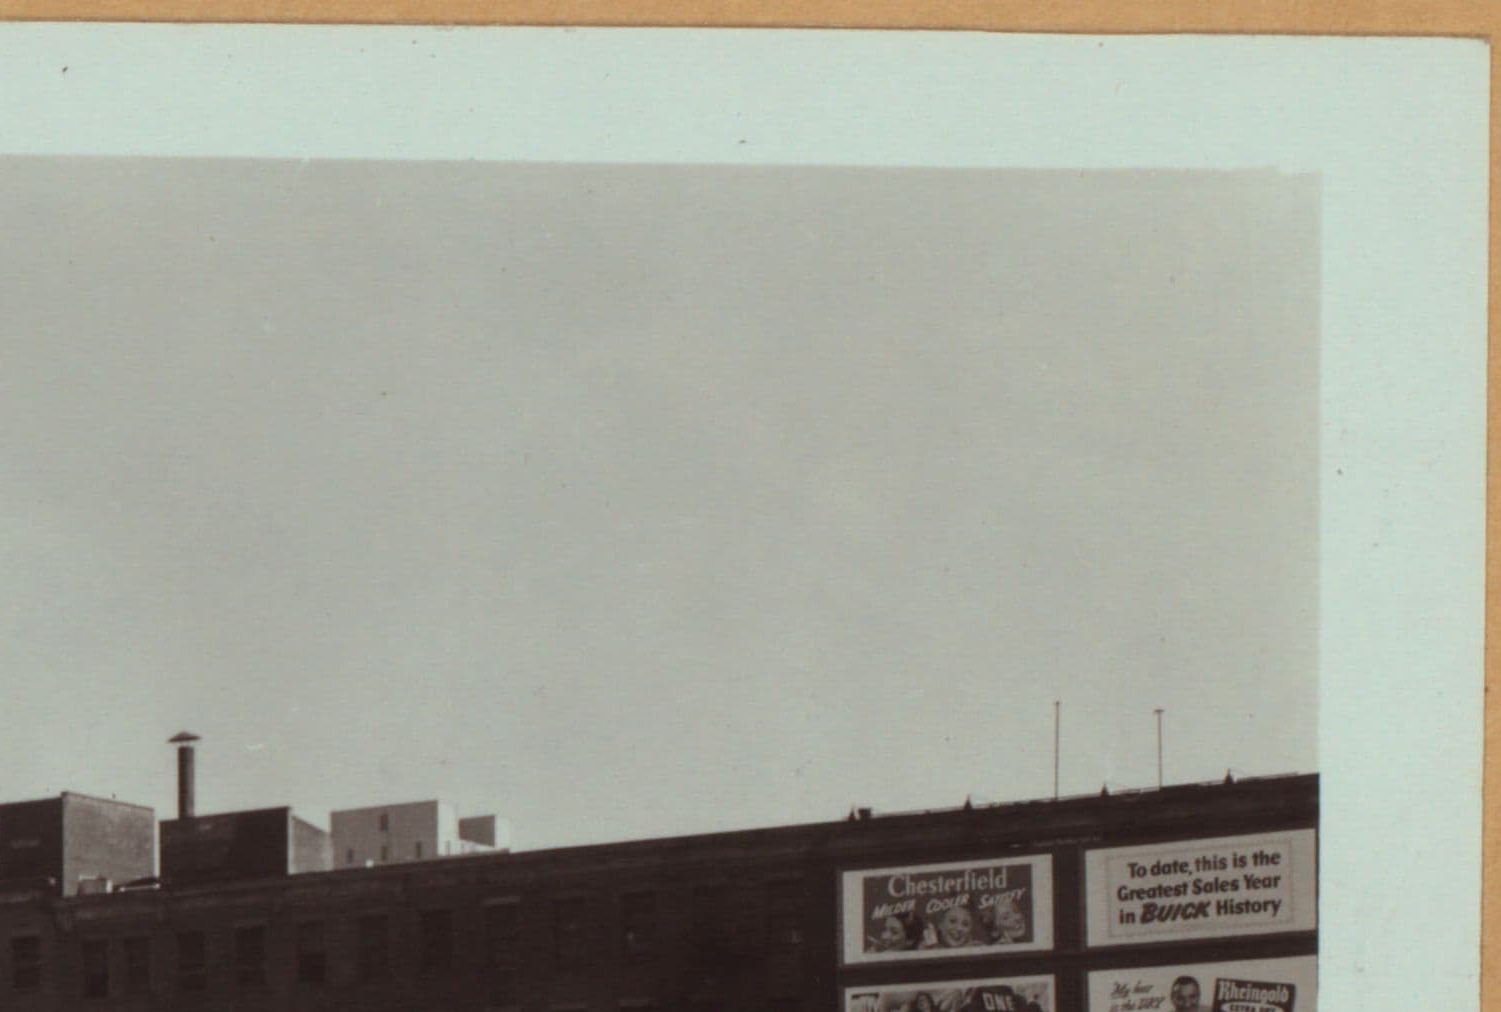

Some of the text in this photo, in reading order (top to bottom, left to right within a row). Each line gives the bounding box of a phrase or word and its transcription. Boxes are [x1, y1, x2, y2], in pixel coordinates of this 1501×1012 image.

[1128, 849, 1282, 879] To date, this is the
[888, 867, 1007, 897] Chesterfield
[1117, 874, 1282, 903] Greatest Sales Year
[871, 899, 917, 921] MILDER
[925, 894, 971, 914] COOLER
[1119, 899, 1283, 925] in BUICK History
[982, 991, 1016, 1012] ONE
[1217, 980, 1290, 1005] Rheingold
